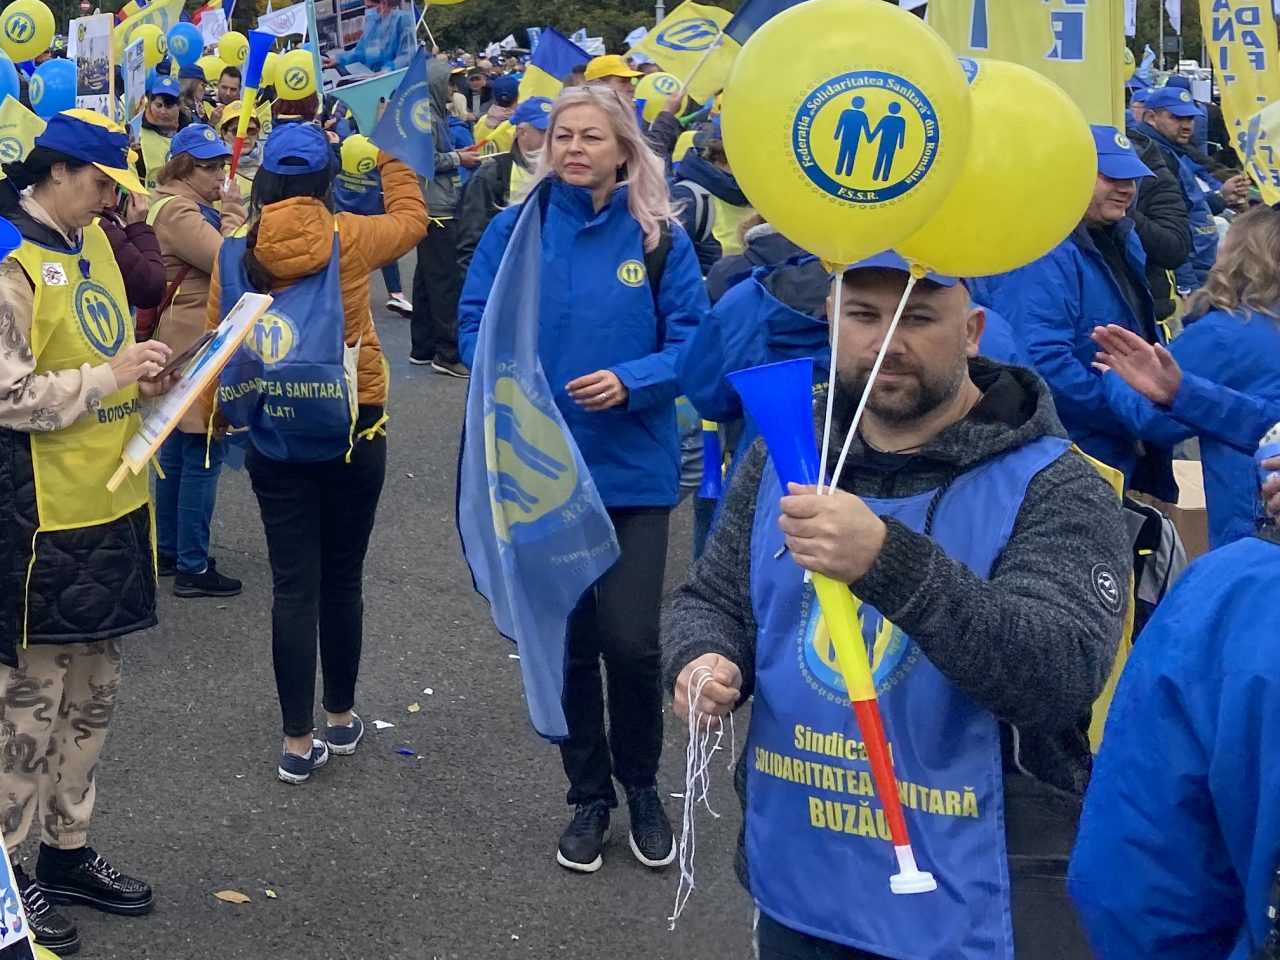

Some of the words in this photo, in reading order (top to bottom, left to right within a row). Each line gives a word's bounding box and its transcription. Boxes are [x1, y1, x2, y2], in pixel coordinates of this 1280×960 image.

[796, 116, 814, 168] Federația
[925, 119, 935, 138] din
[904, 142, 936, 186] România
[837, 187, 879, 201] F.S.S.R.
[286, 378, 344, 400] SANITARĂ
[755, 747, 875, 798] SOLIDARITATEA
[808, 795, 894, 841] BUZĂU
